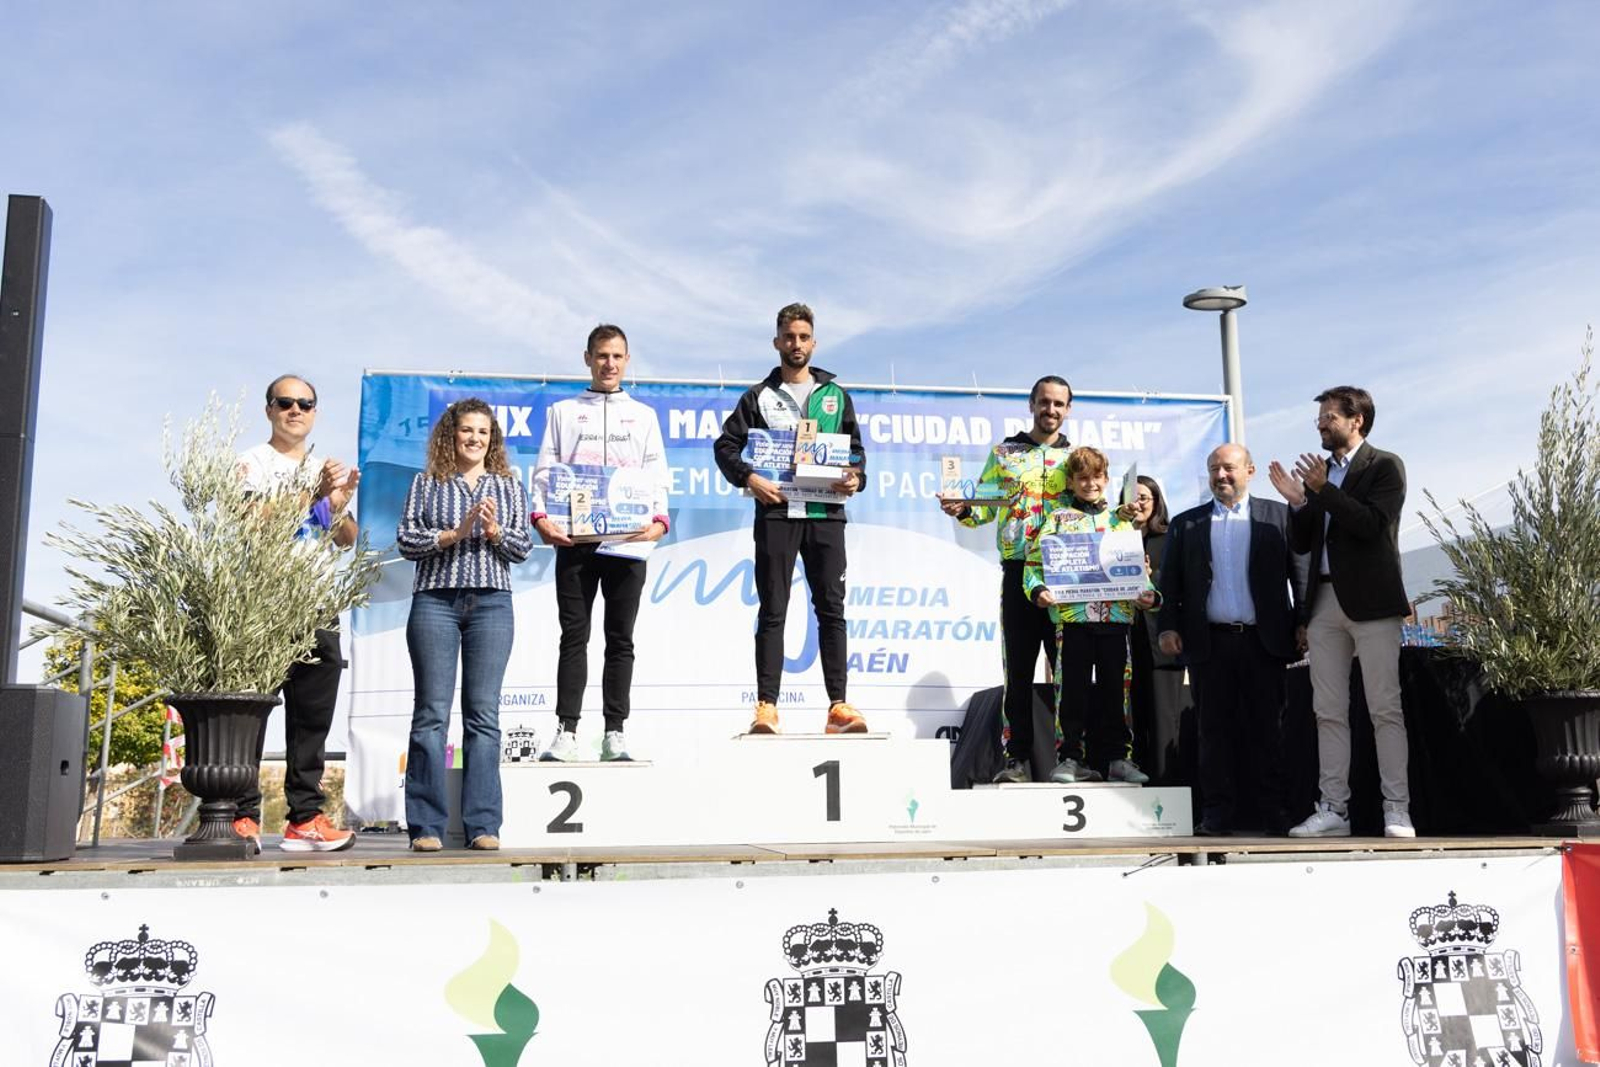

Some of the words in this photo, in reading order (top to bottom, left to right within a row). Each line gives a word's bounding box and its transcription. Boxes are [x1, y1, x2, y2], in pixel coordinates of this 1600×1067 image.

[805, 422, 811, 433] 1
[947, 460, 955, 470] 3
[879, 471, 940, 499] PAC
[577, 493, 586, 503] 2
[847, 586, 950, 607] MEDIA
[846, 615, 997, 641] MARATÓN
[846, 648, 909, 673] AÉN
[498, 693, 546, 706] RGANIZA
[741, 691, 806, 703] PACINA
[812, 760, 841, 822] 1
[546, 781, 584, 834] 2
[1062, 795, 1087, 833] 3
[196, 998, 206, 1031] CASTILLA
[773, 997, 781, 1018] NOBLE
